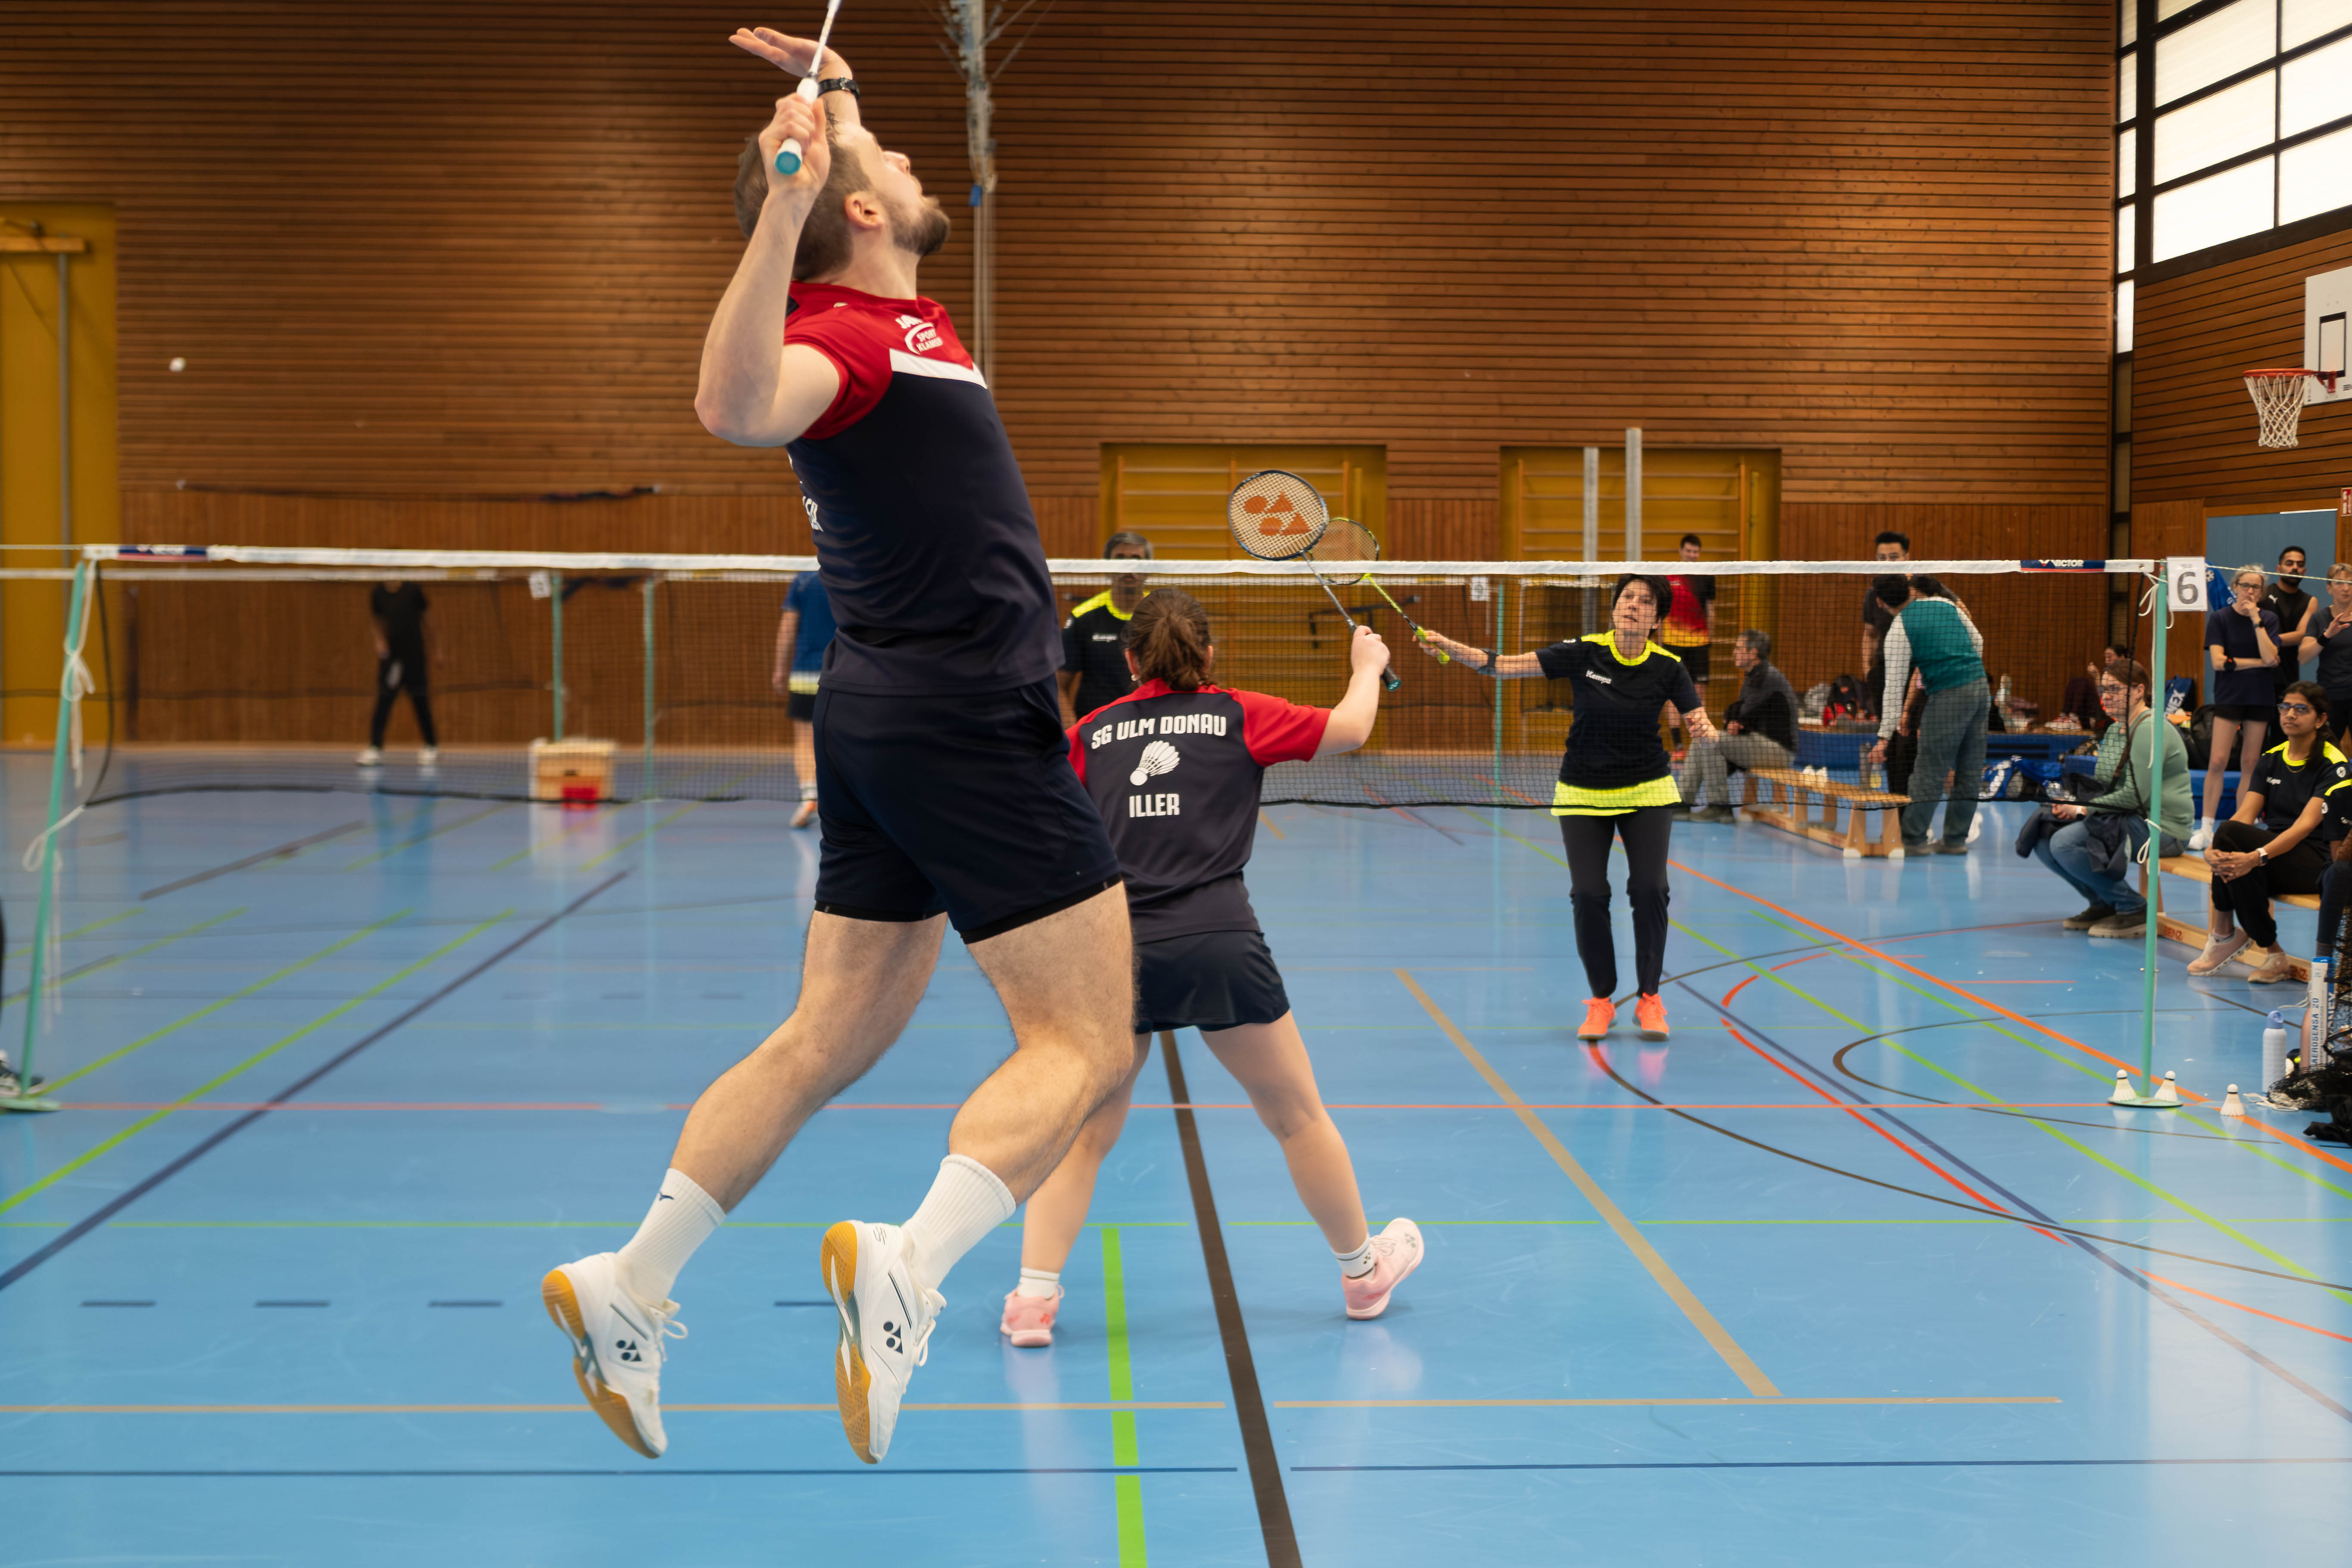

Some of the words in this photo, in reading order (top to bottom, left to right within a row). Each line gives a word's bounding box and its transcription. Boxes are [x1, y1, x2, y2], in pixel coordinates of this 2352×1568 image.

[916, 328, 937, 342] SPORT
[2177, 571, 2198, 604] 6
[1586, 670, 1612, 684] Kempa
[1091, 724, 1112, 749] SG
[1116, 718, 1156, 740] ULM
[1160, 714, 1226, 736] DONAU
[1129, 793, 1180, 818] ILLER
[2312, 998, 2319, 1009] 20
[2311, 1013, 2319, 1064] AEROSENSA
